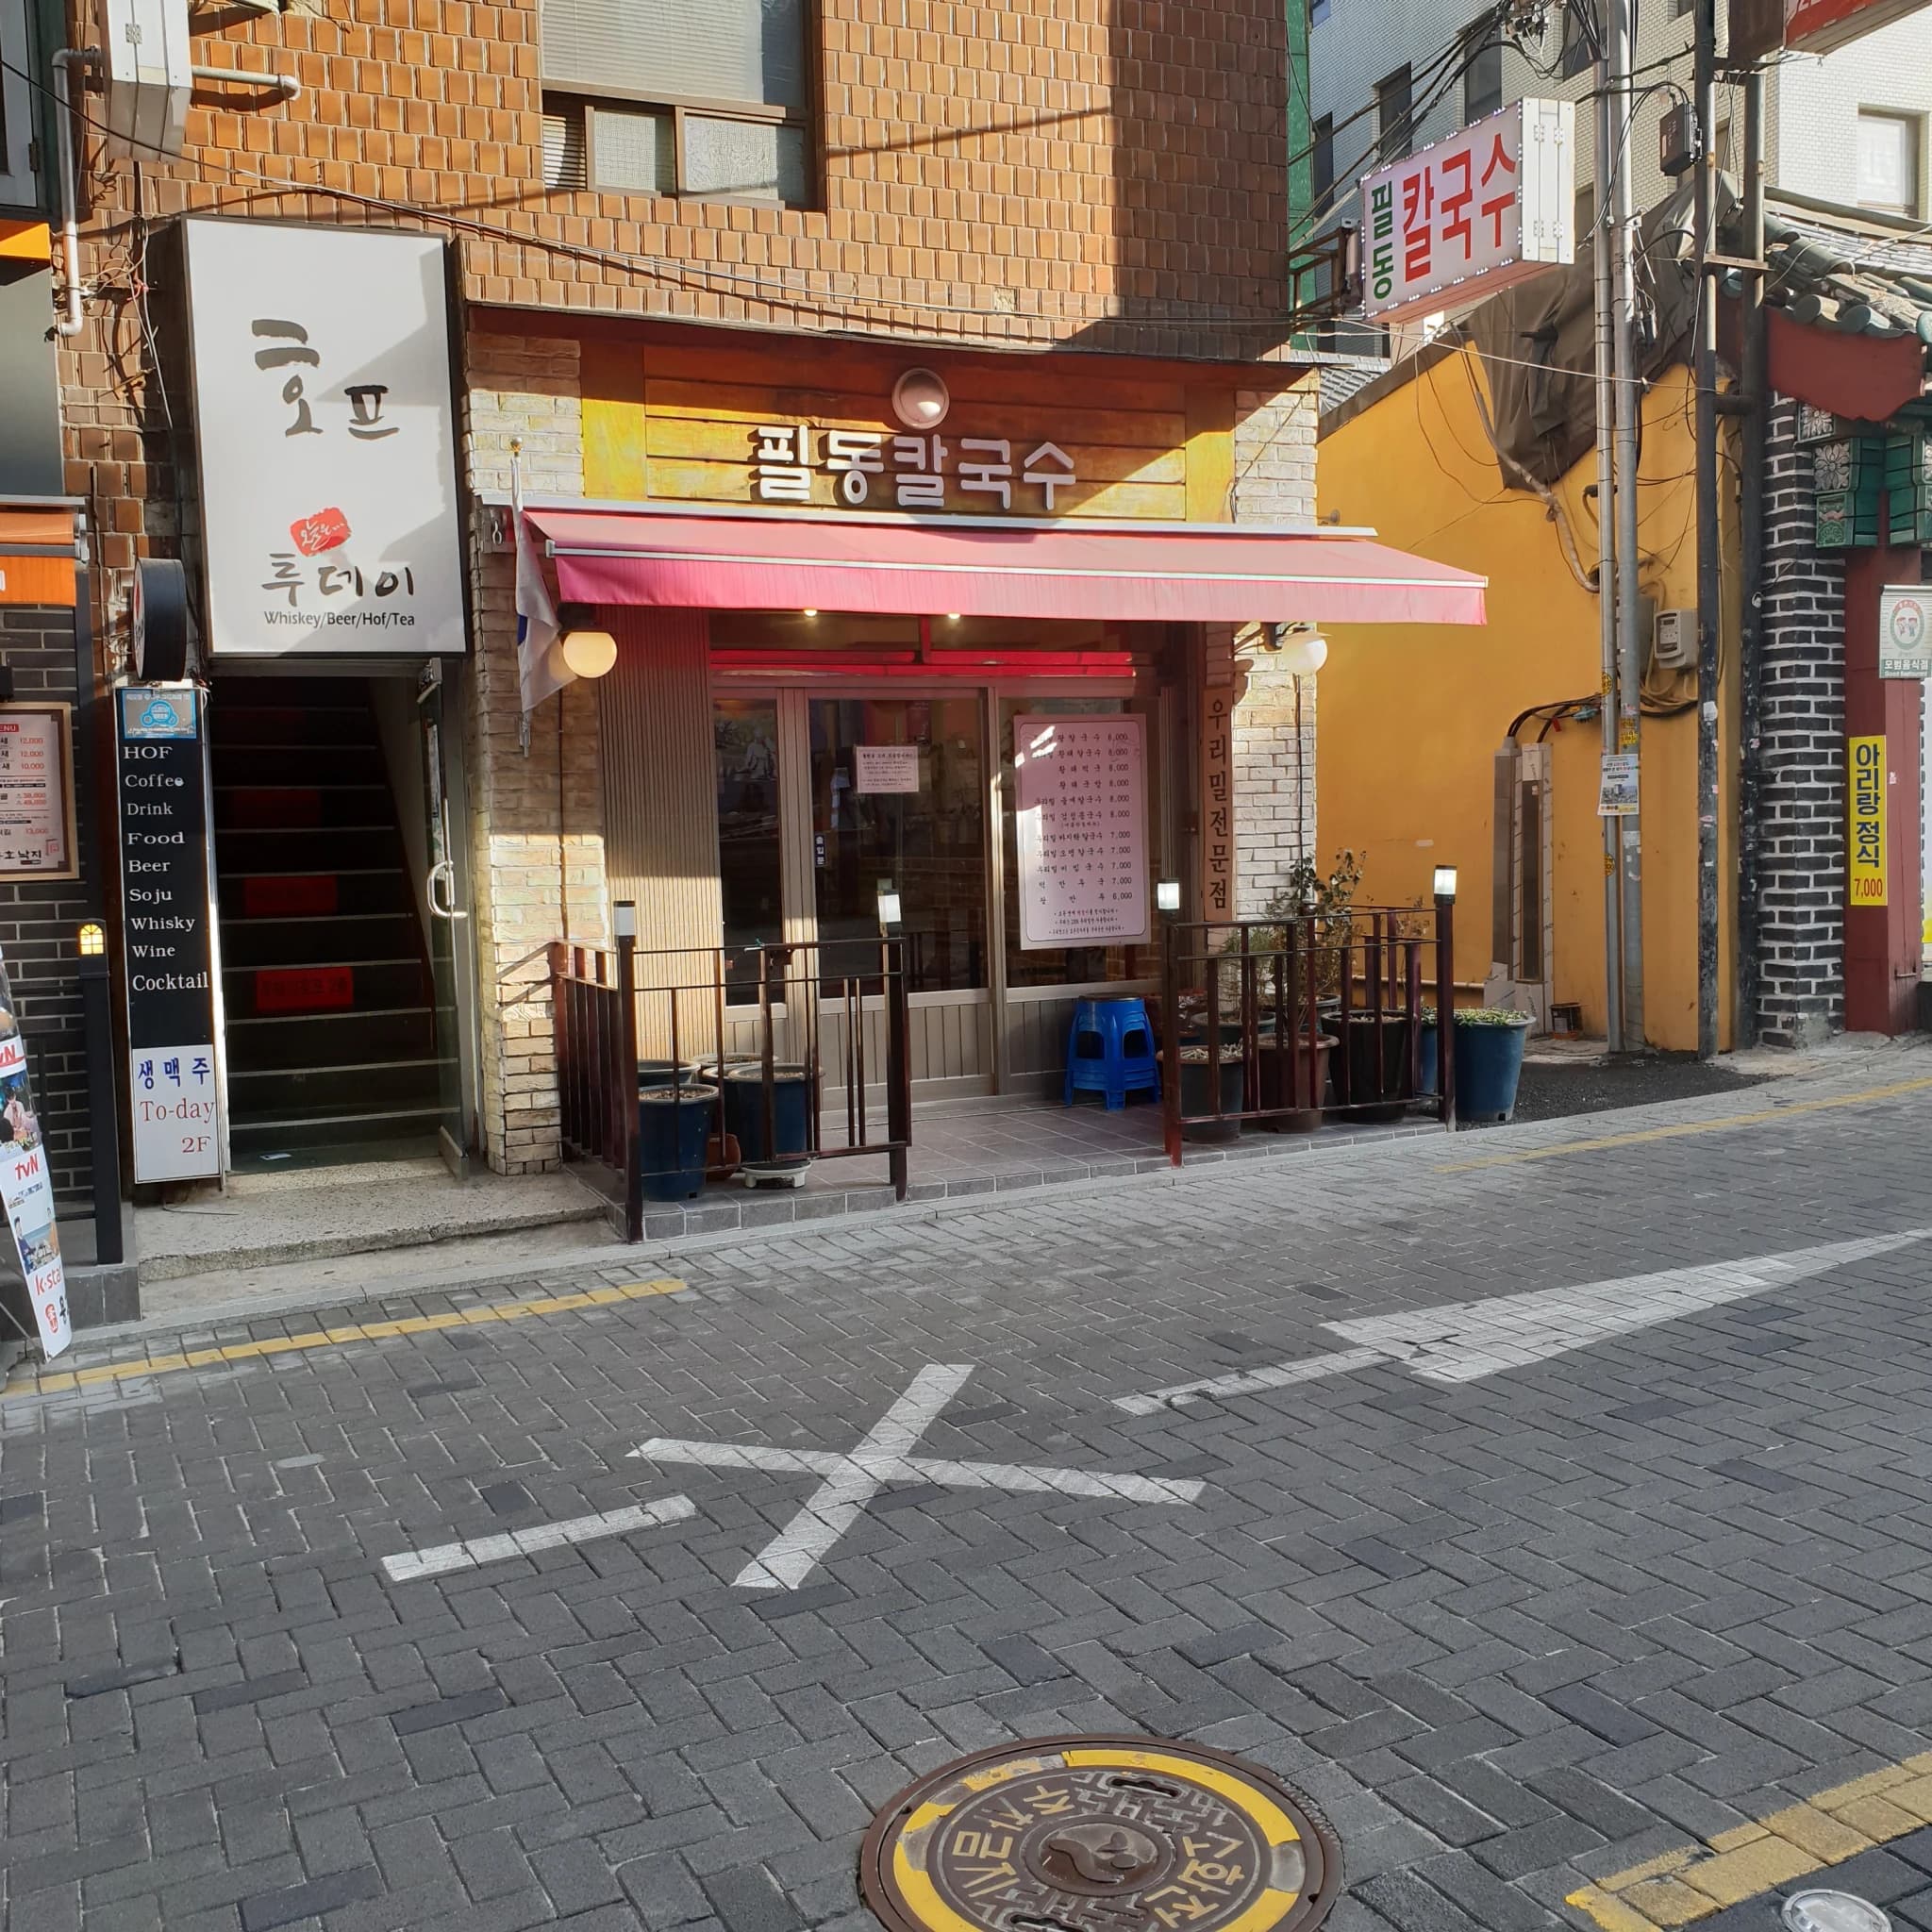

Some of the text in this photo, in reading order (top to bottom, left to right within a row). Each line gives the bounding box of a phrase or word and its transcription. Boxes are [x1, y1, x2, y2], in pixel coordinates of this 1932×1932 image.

[1403, 133, 1515, 282] 칼국수
[1371, 180, 1392, 300] 필동
[251, 319, 400, 440] 호프
[758, 425, 1076, 510] 필동칼국수
[262, 553, 414, 607] 투데이
[264, 611, 414, 628] Whiskey/Beer/Hof/Tea
[124, 746, 173, 759] HOF
[125, 774, 184, 788] Coffee
[127, 803, 173, 815] Drink
[1208, 699, 1228, 909] 우리밀전문점
[1856, 742, 1880, 869] 아리랑 정식
[128, 832, 185, 845] Food
[129, 859, 170, 873] Beer
[129, 889, 173, 904] Soju
[1854, 877, 1883, 899] 7,000
[130, 916, 195, 932] Whisky
[132, 945, 175, 958] Wine
[133, 972, 208, 991] Cocktail
[139, 1058, 210, 1090] 생맥주
[140, 1097, 216, 1124] To-day
[181, 1137, 212, 1154] 2F
[15, 1153, 39, 1180] tvN
[1144, 1831, 1243, 1928] 소화전
